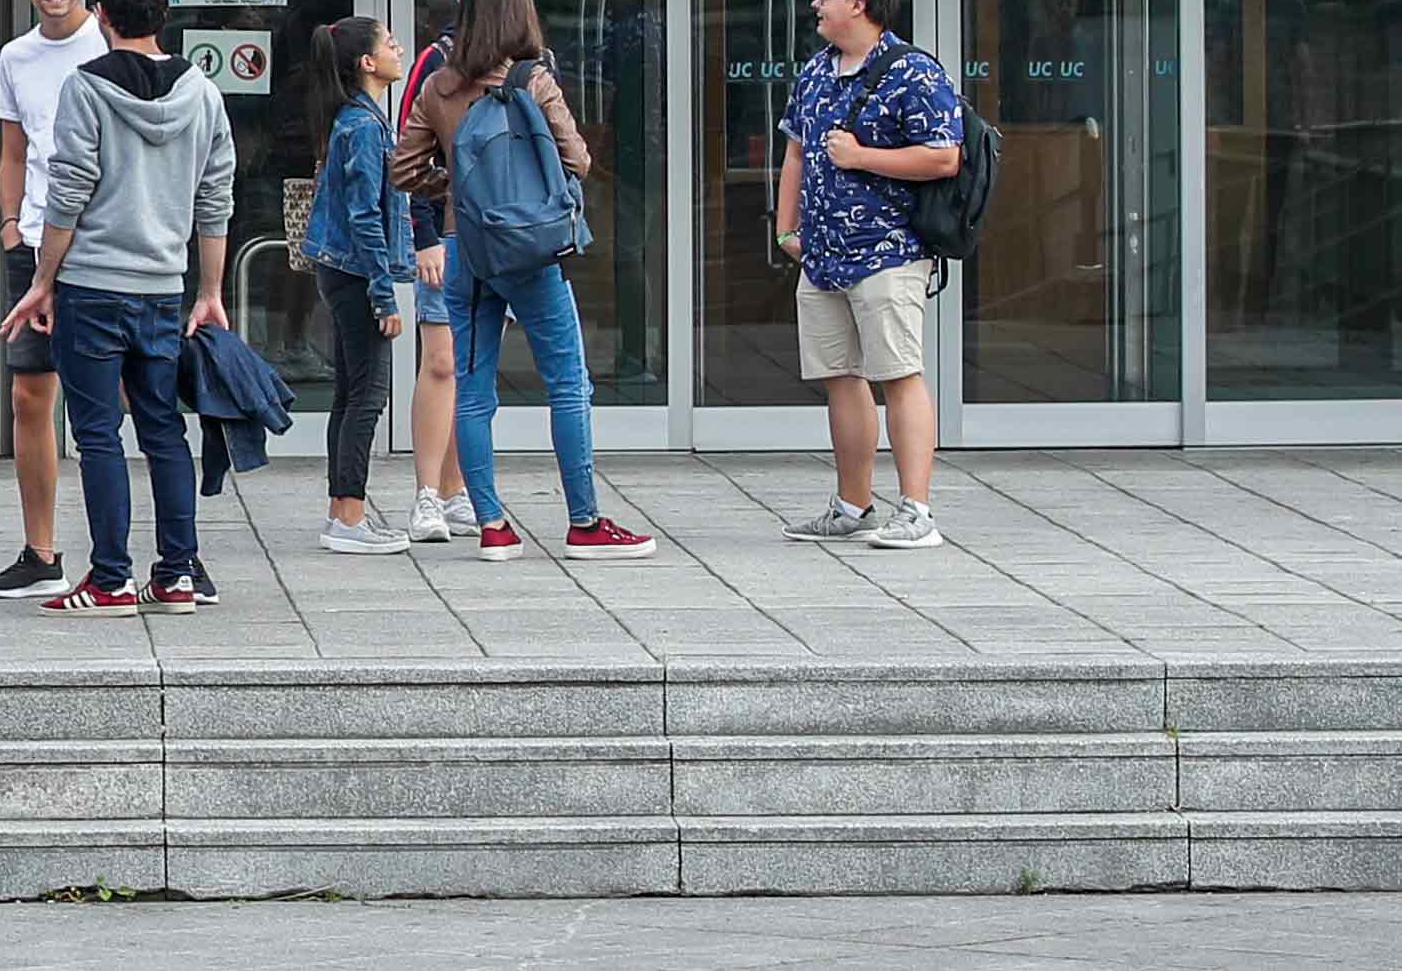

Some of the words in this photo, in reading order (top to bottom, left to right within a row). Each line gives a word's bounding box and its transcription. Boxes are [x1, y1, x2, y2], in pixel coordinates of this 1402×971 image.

[729, 62, 753, 78] UC
[761, 62, 785, 78] UC
[964, 61, 990, 77] UC
[1028, 61, 1053, 77] UC
[1060, 61, 1085, 77] UC
